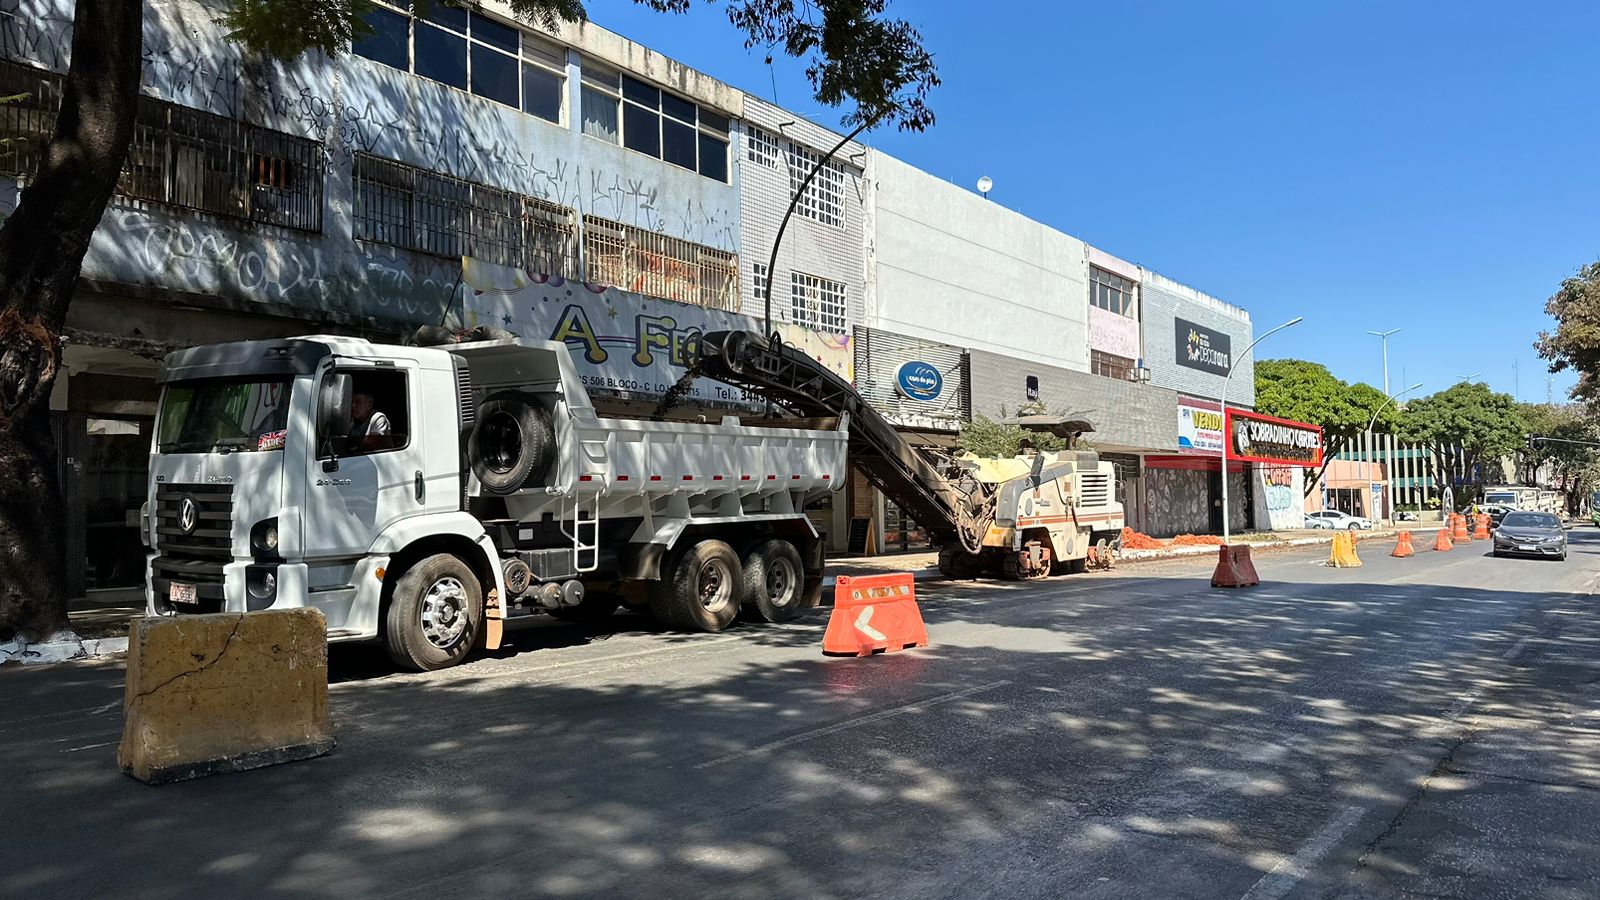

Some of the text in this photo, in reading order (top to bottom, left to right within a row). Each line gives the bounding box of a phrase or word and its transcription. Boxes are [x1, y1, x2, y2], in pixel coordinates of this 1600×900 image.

[550, 304, 608, 364] A
[590, 376, 605, 386] 506
[607, 379, 637, 390] BLOCO
[644, 382, 650, 391] C
[715, 386, 737, 400] Tel.:
[1250, 421, 1294, 447] SOBRADINHO
